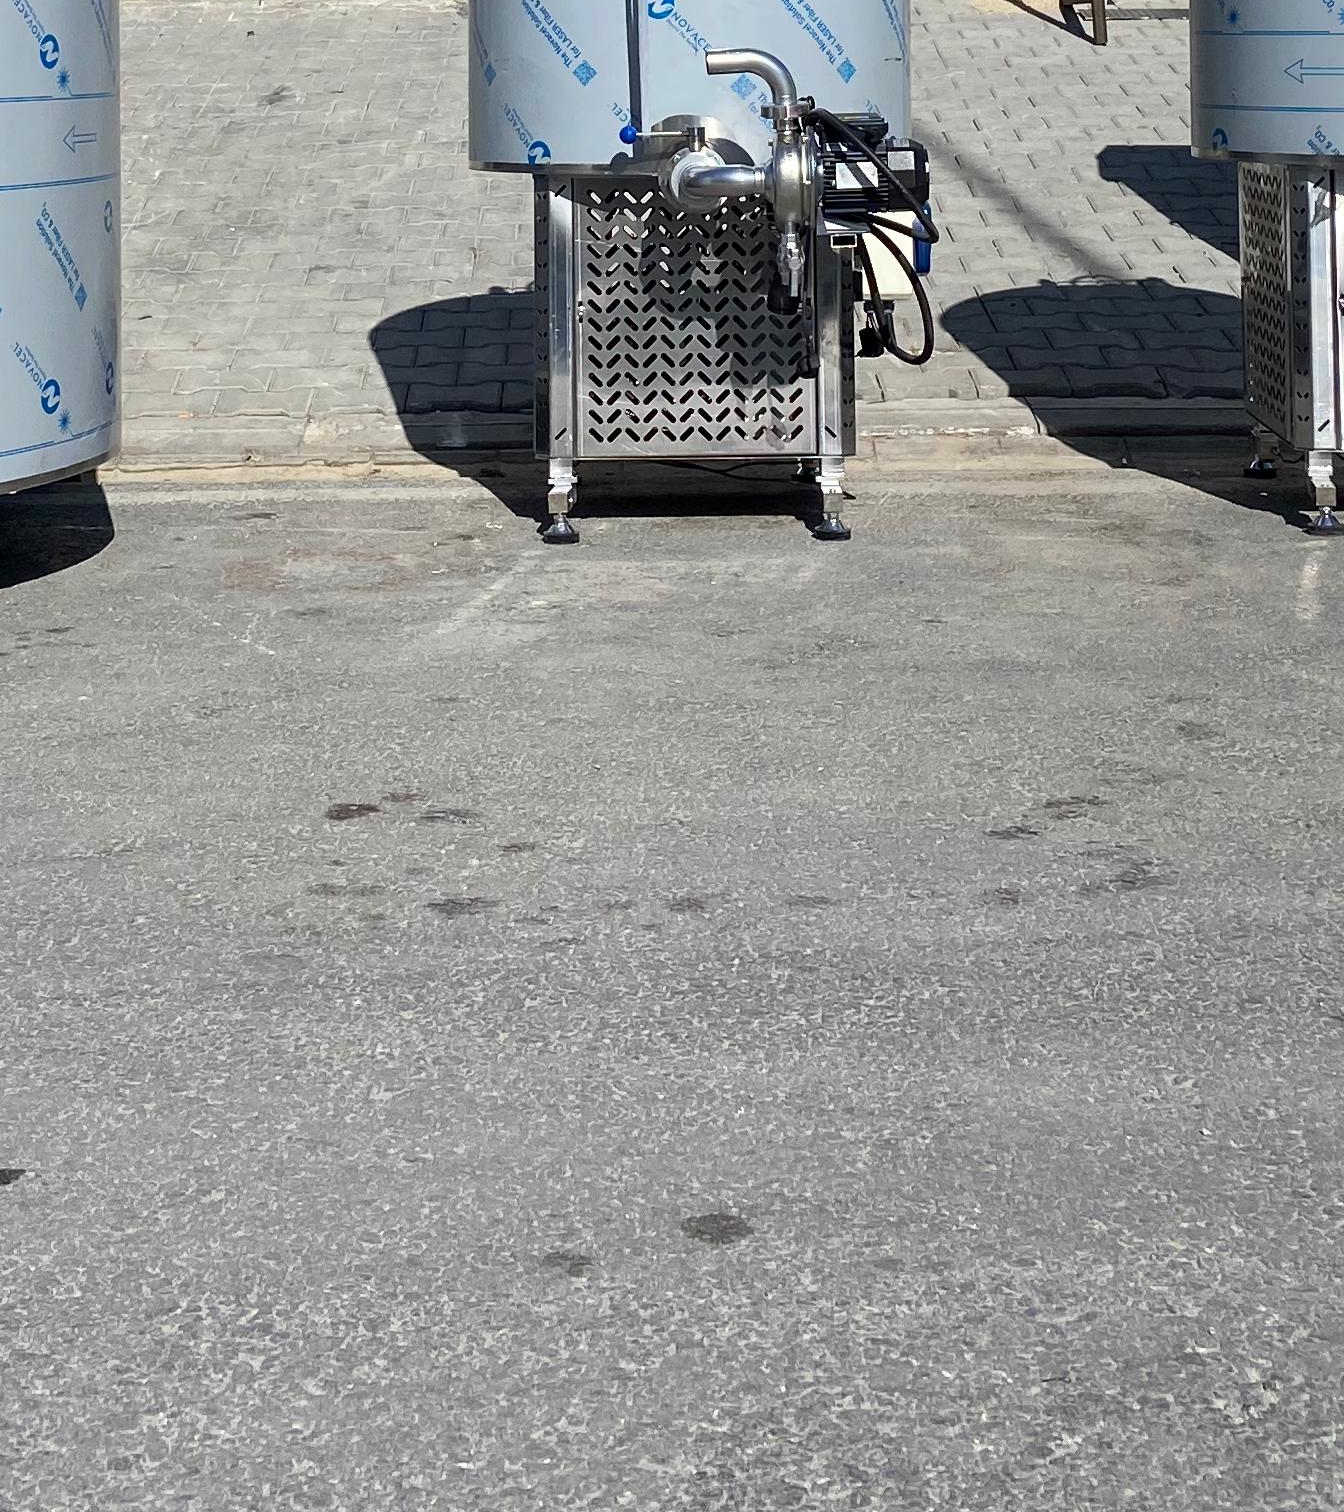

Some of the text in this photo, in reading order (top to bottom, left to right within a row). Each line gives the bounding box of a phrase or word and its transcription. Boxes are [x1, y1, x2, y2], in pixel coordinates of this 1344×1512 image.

[671, 11, 713, 52] NOVACE
[561, 51, 572, 68] The
[570, 46, 581, 58] for
[826, 50, 836, 66] The
[504, 103, 531, 148] NOVACEL
[13, 342, 44, 390] NOVACEL
